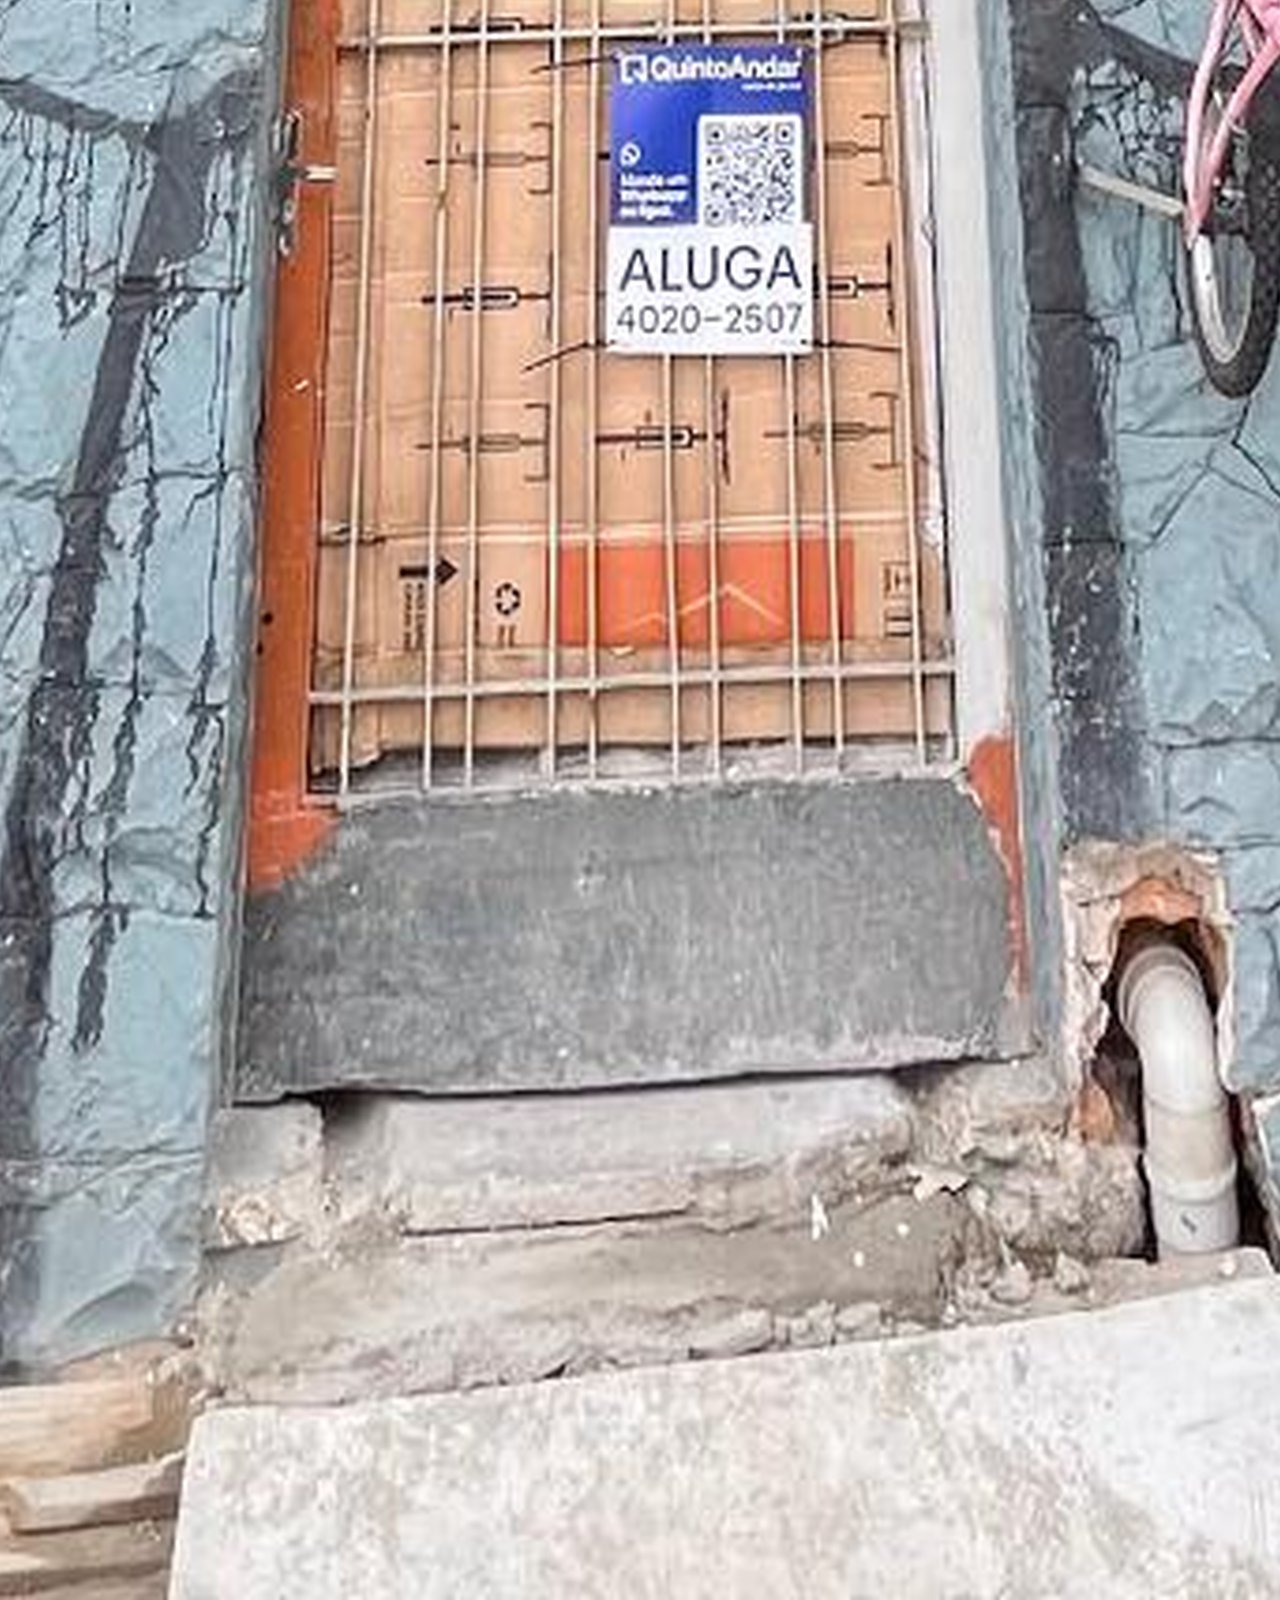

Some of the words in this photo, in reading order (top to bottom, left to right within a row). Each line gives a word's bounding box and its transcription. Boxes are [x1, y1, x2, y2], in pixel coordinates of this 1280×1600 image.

[650, 53, 802, 81] QuintoAndar
[619, 245, 802, 291] ALUGA
[617, 303, 804, 334] 4020-2507
